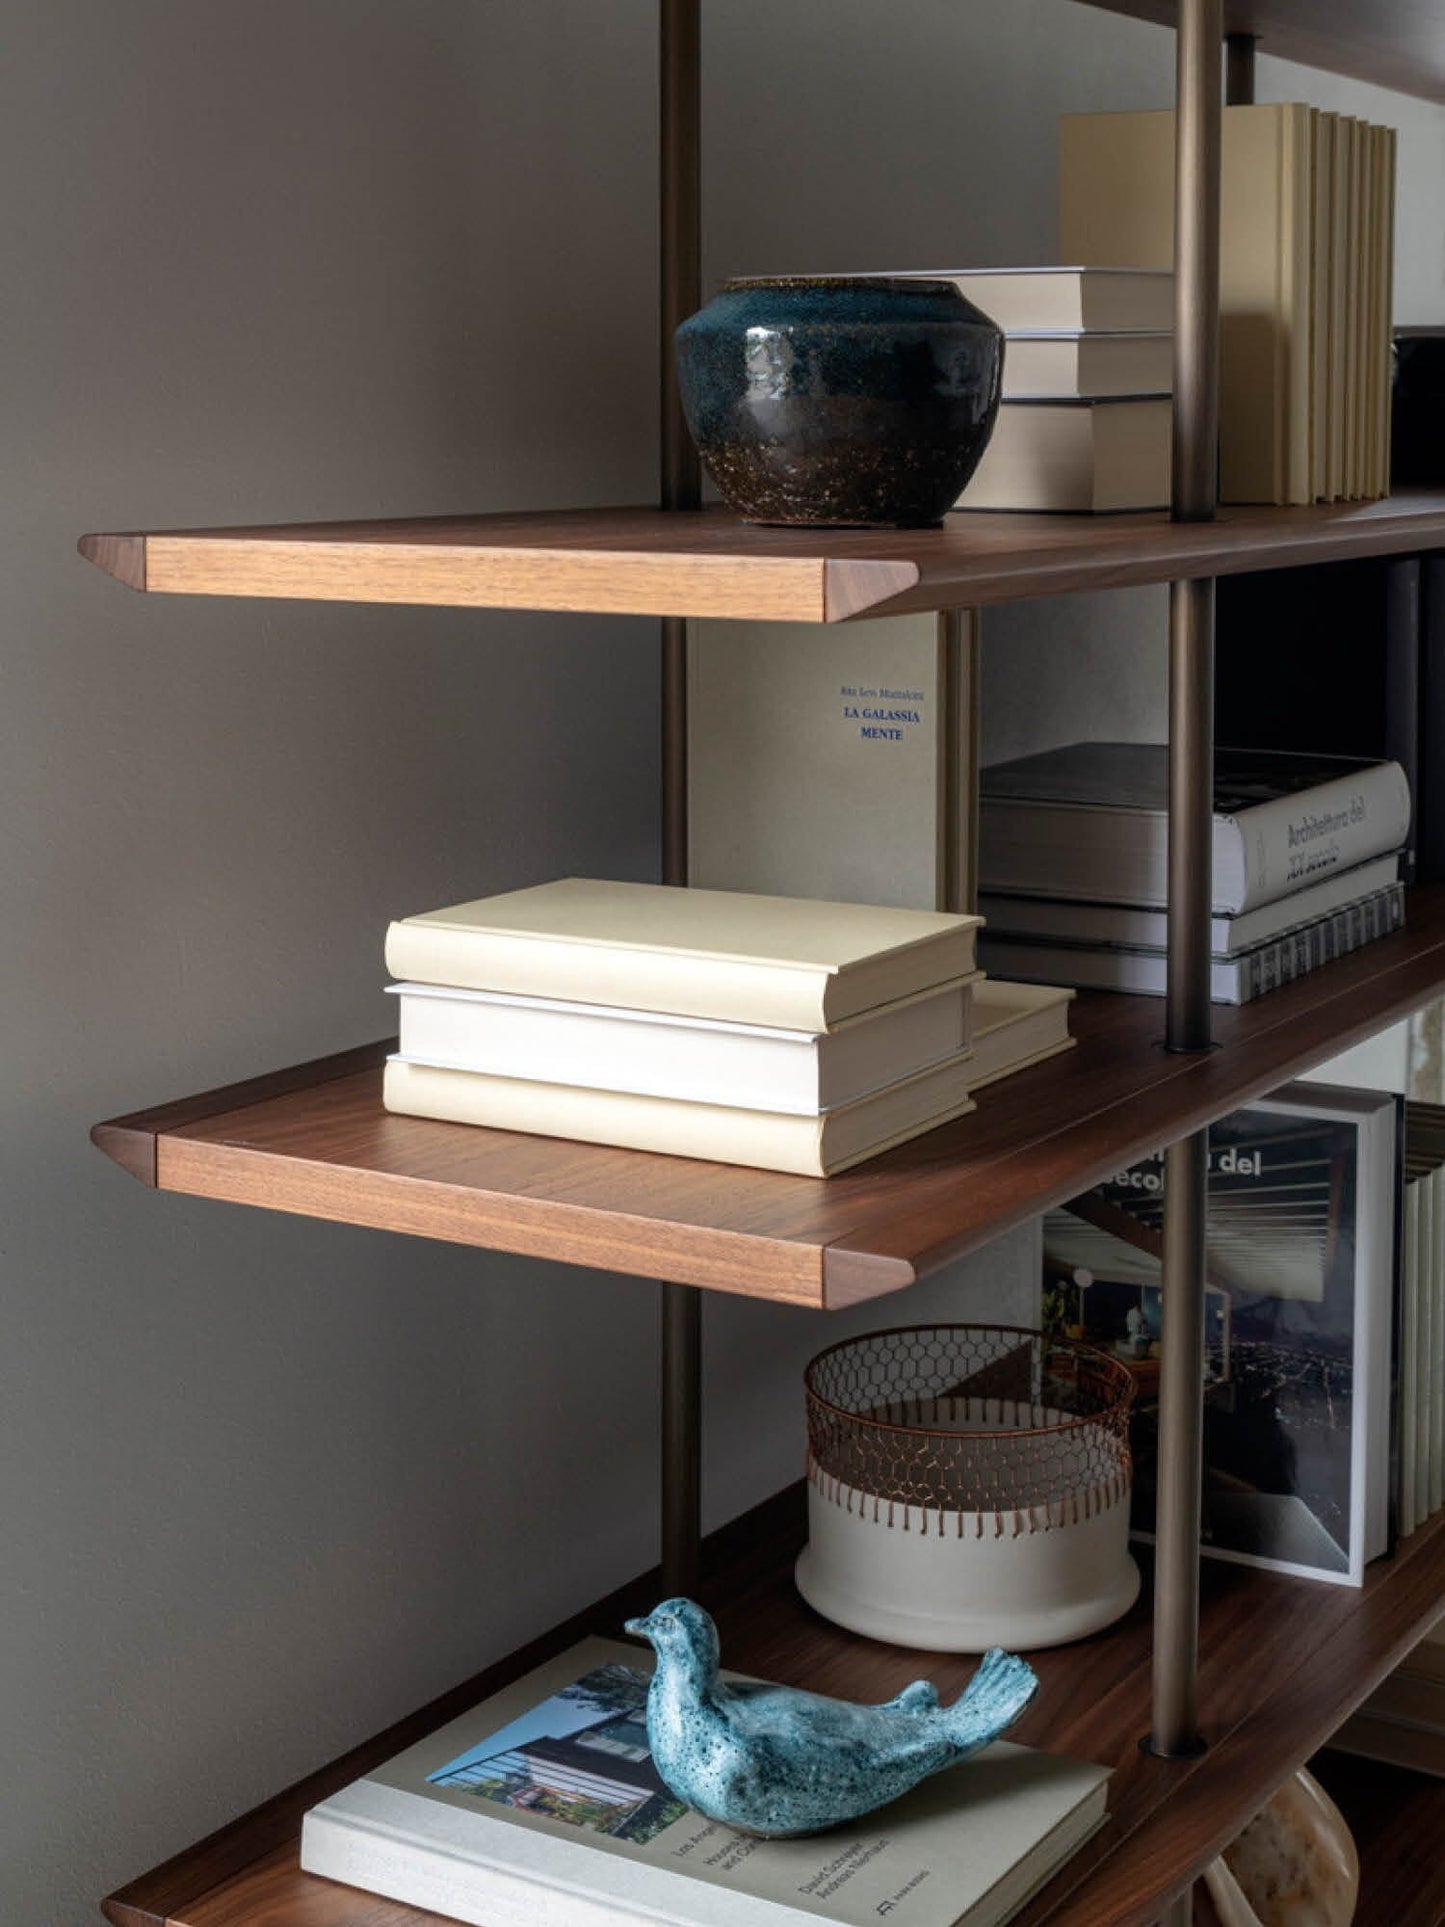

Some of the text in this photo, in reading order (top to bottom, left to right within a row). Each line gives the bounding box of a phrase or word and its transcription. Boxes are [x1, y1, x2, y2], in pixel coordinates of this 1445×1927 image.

[843, 705, 920, 722] LA GALASSIA
[860, 726, 904, 740] MENTE
[1287, 811, 1348, 848] Architettura
[1218, 1148, 1262, 1176] del
[1107, 1168, 1165, 1192] ecol
